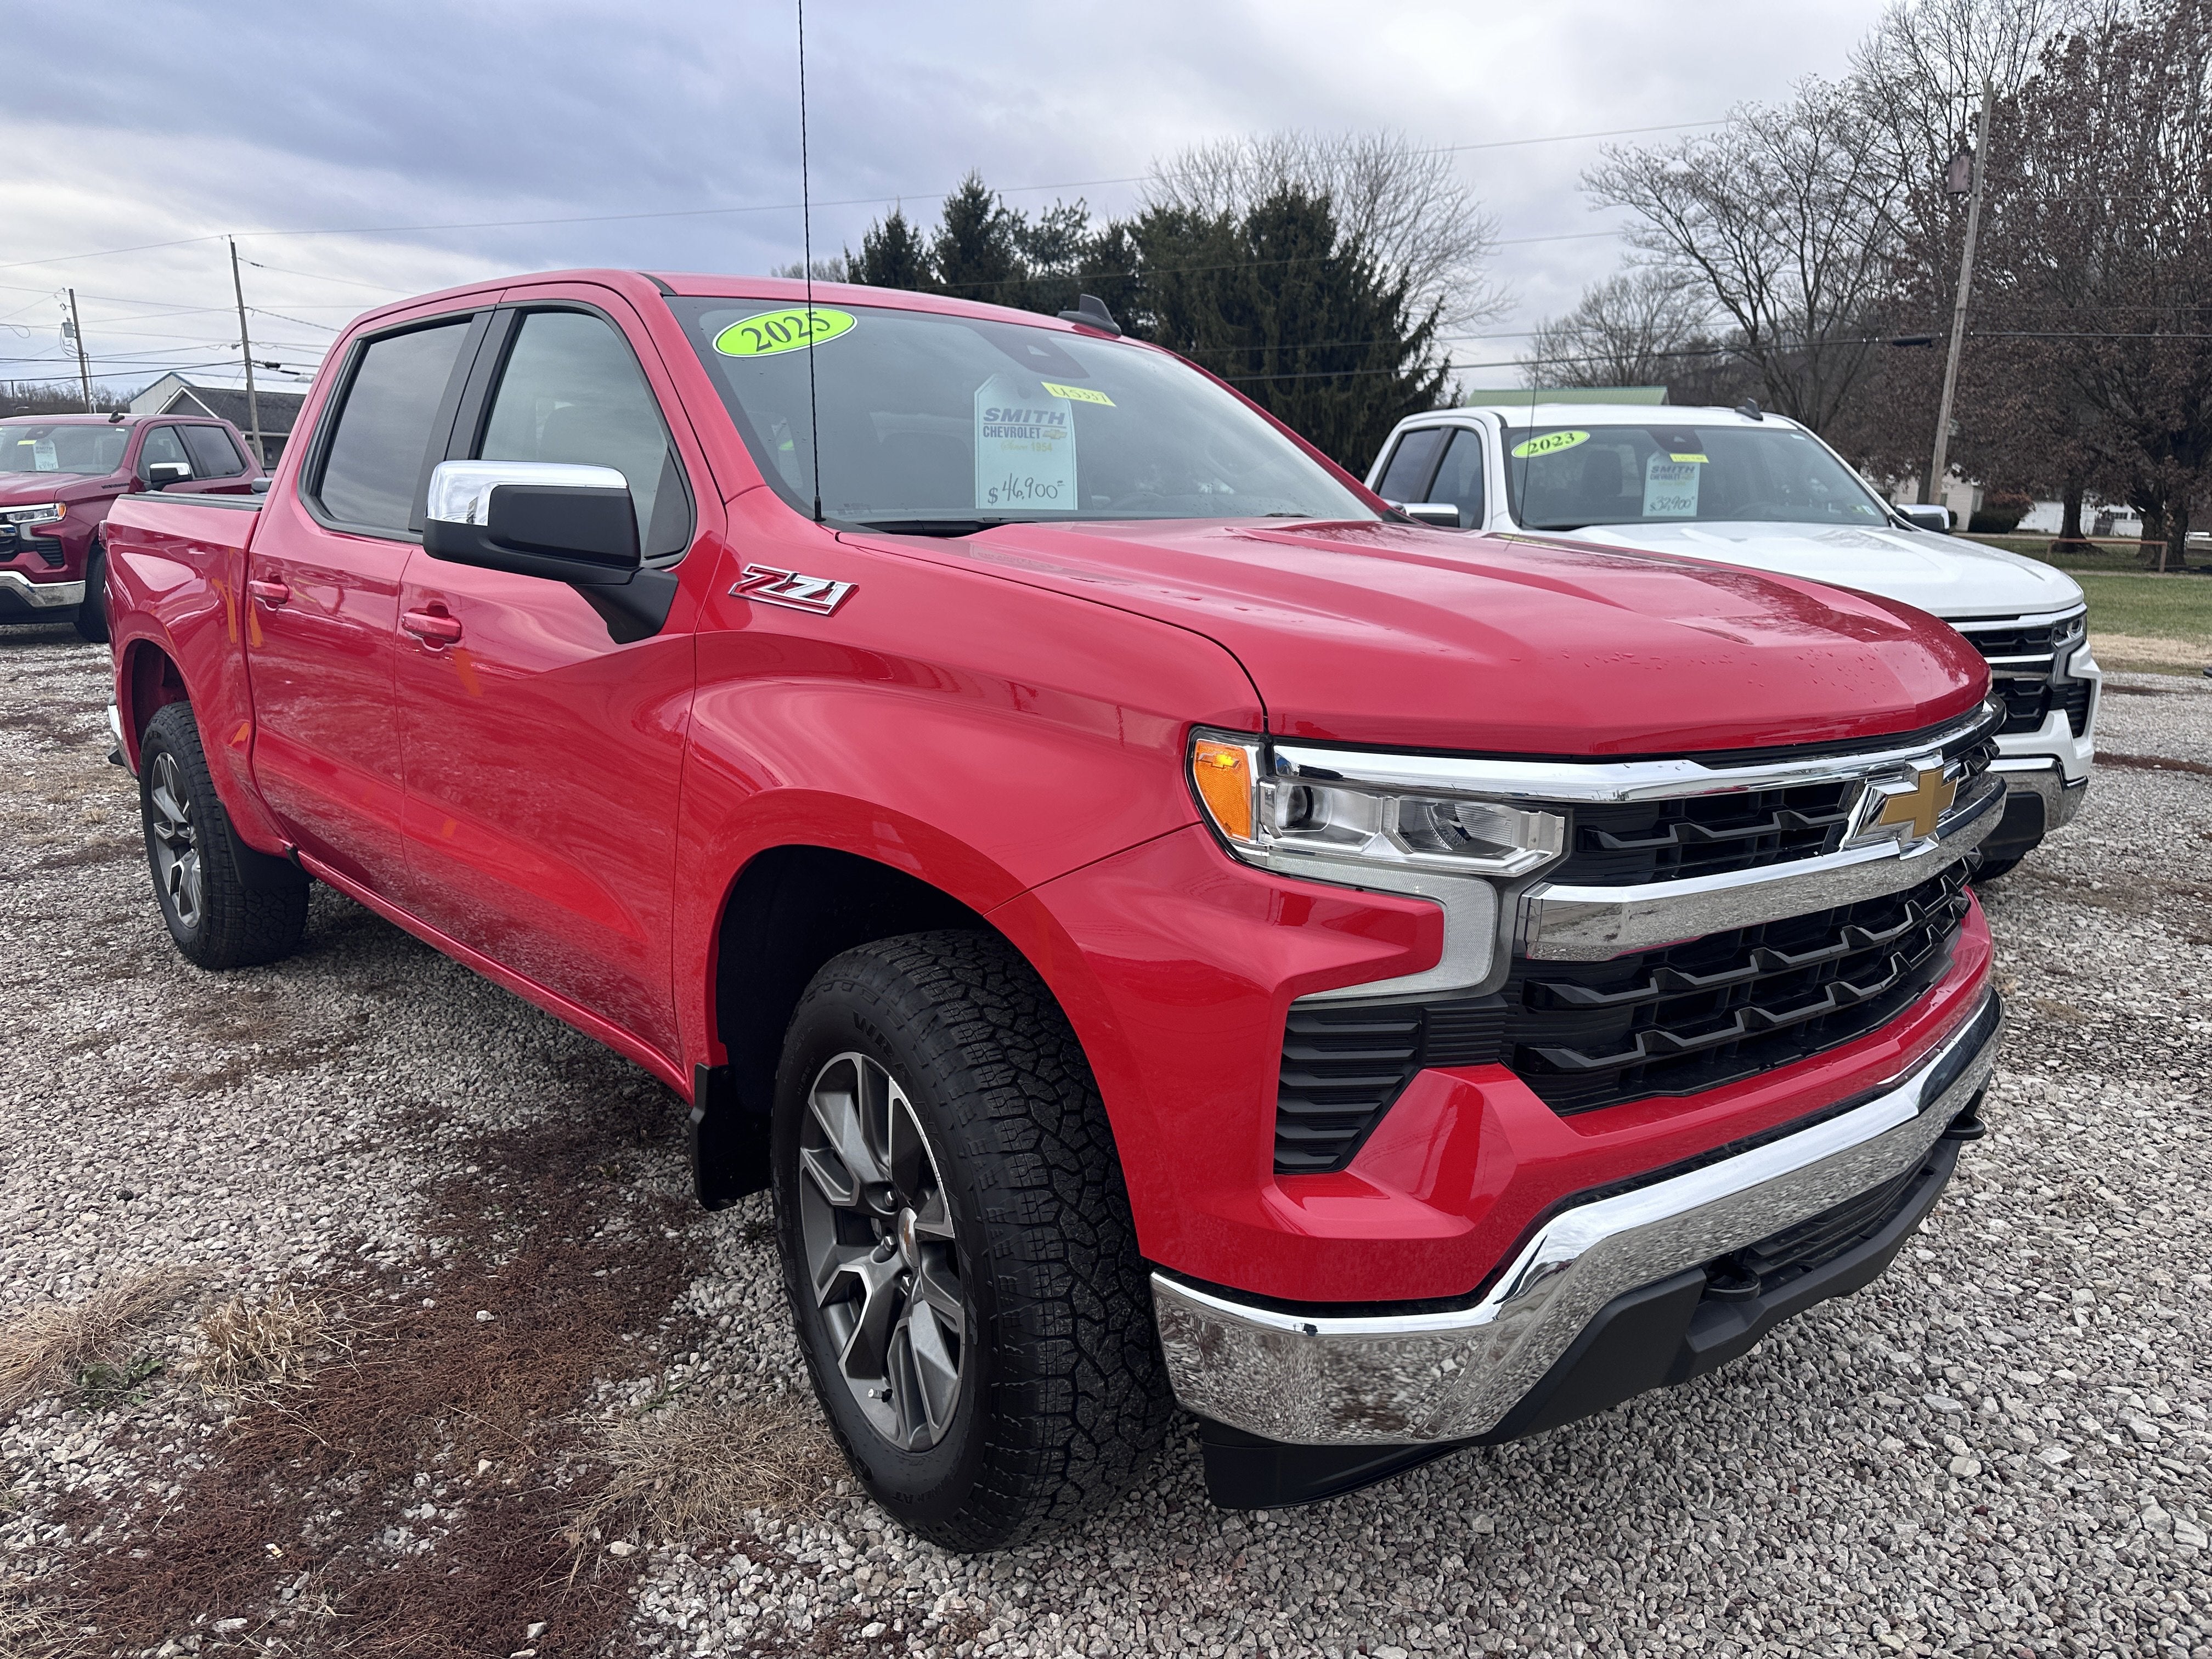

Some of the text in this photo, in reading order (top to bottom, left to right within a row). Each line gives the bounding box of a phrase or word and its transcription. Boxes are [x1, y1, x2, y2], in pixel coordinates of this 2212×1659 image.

[741, 311, 831, 352] 2025
[983, 407, 1065, 425] SMITH
[983, 425, 1041, 439] CHEVROLET
[1031, 441, 1053, 452] 1954
[1530, 432, 1575, 454] 2023
[1651, 465, 1695, 473] SMITH
[728, 562, 860, 618] Z71
[851, 1008, 979, 1346] WRANGLER
